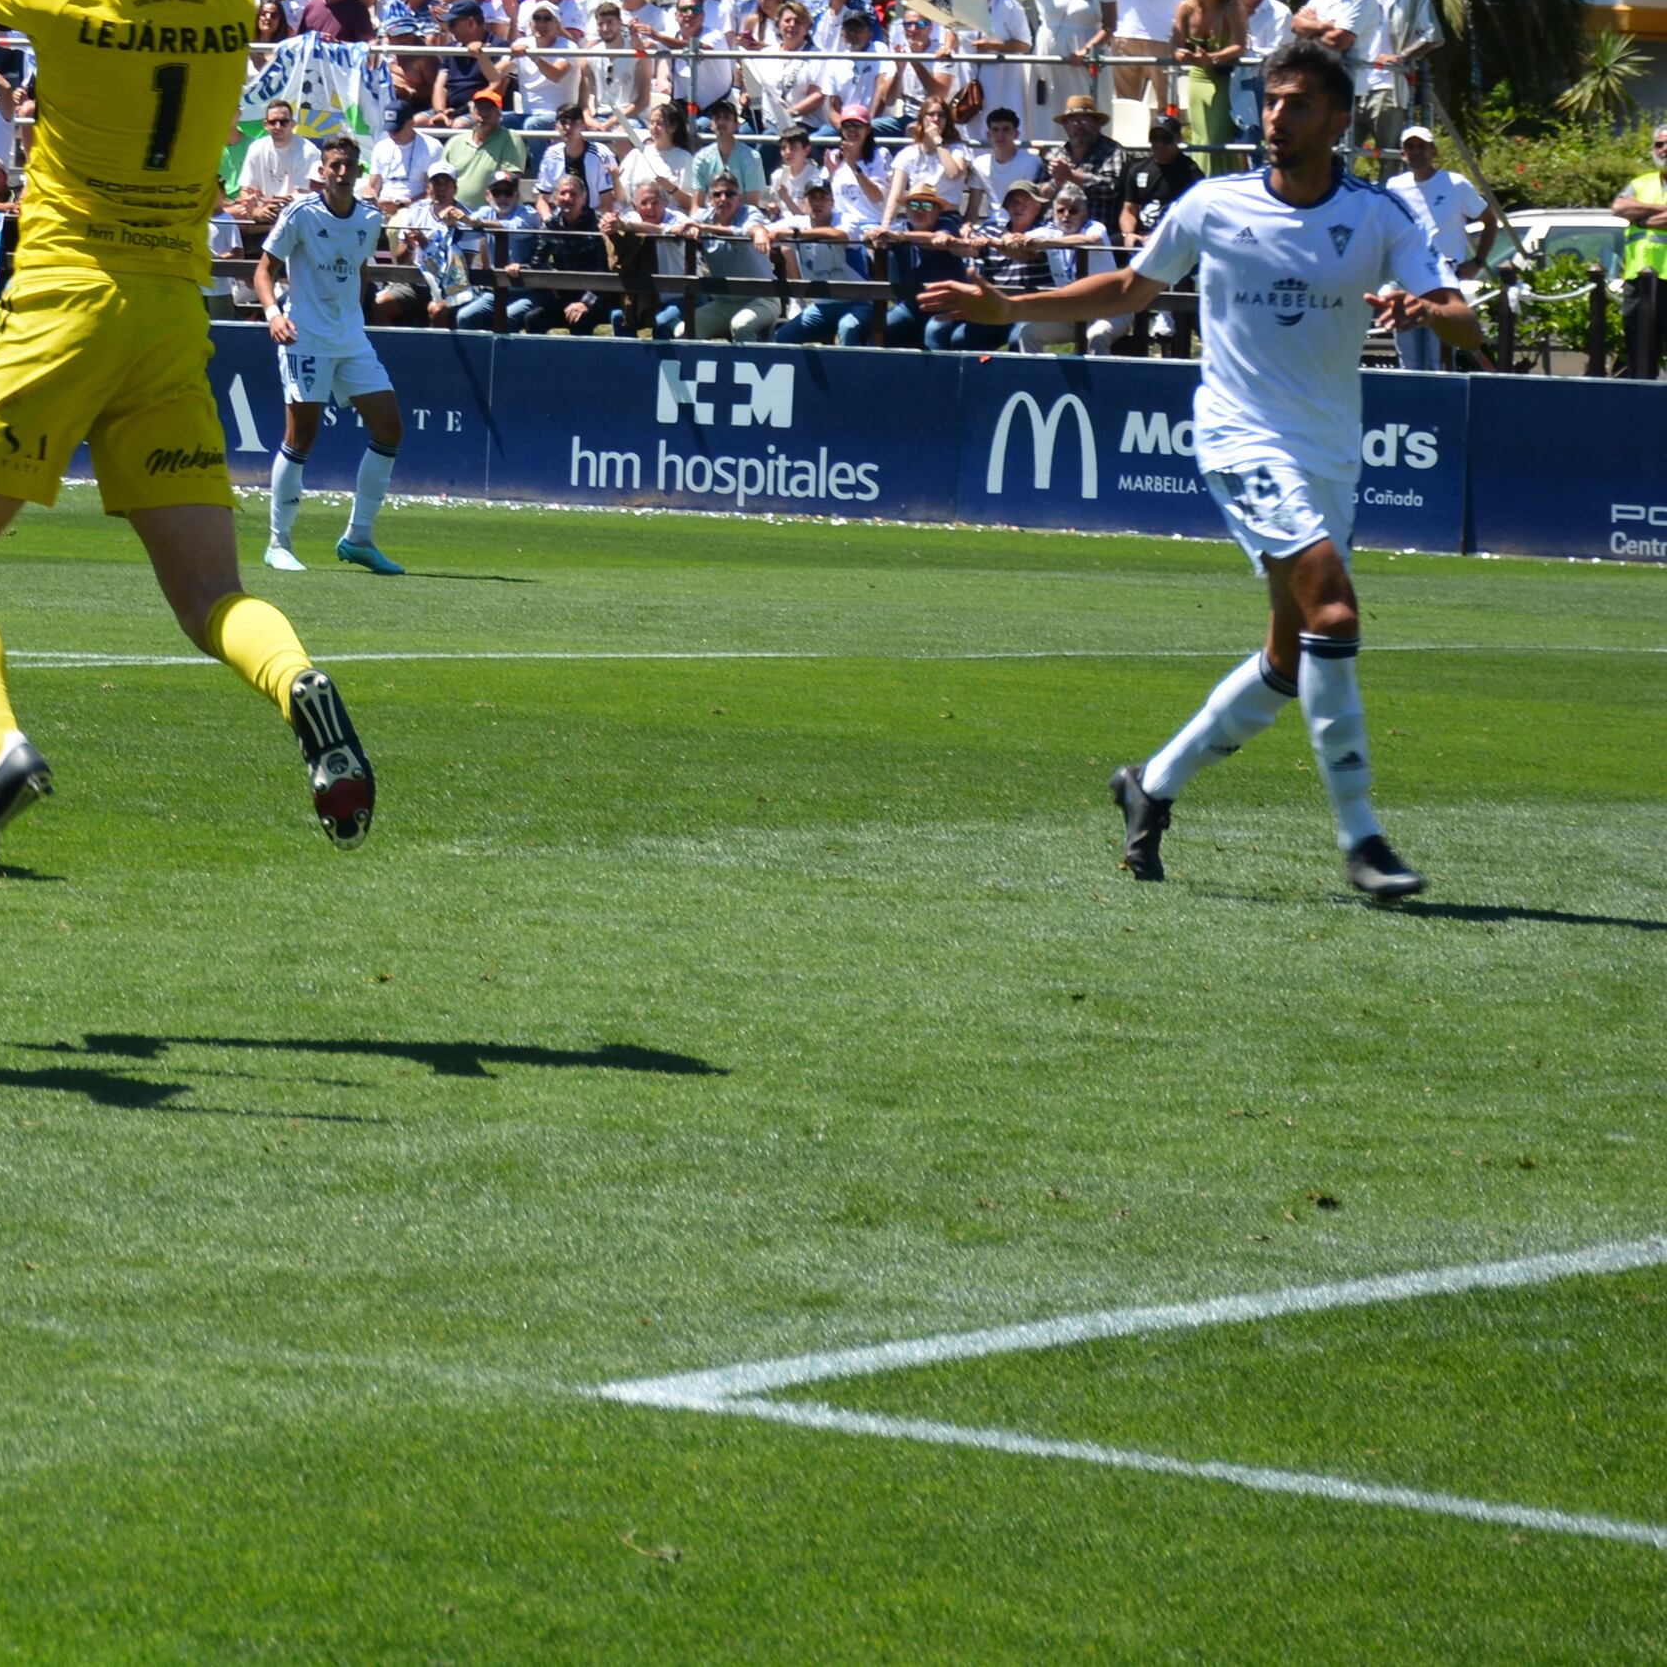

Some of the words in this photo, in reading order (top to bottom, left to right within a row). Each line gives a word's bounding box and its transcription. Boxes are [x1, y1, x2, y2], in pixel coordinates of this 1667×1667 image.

[143, 62, 191, 172] 1
[120, 225, 194, 253] hospitales
[1234, 291, 1344, 310] MARBELLA
[569, 435, 641, 491] hm
[657, 438, 881, 507] hospitales
[1117, 474, 1197, 496] MARBELLA
[1364, 484, 1425, 508] Cañada
